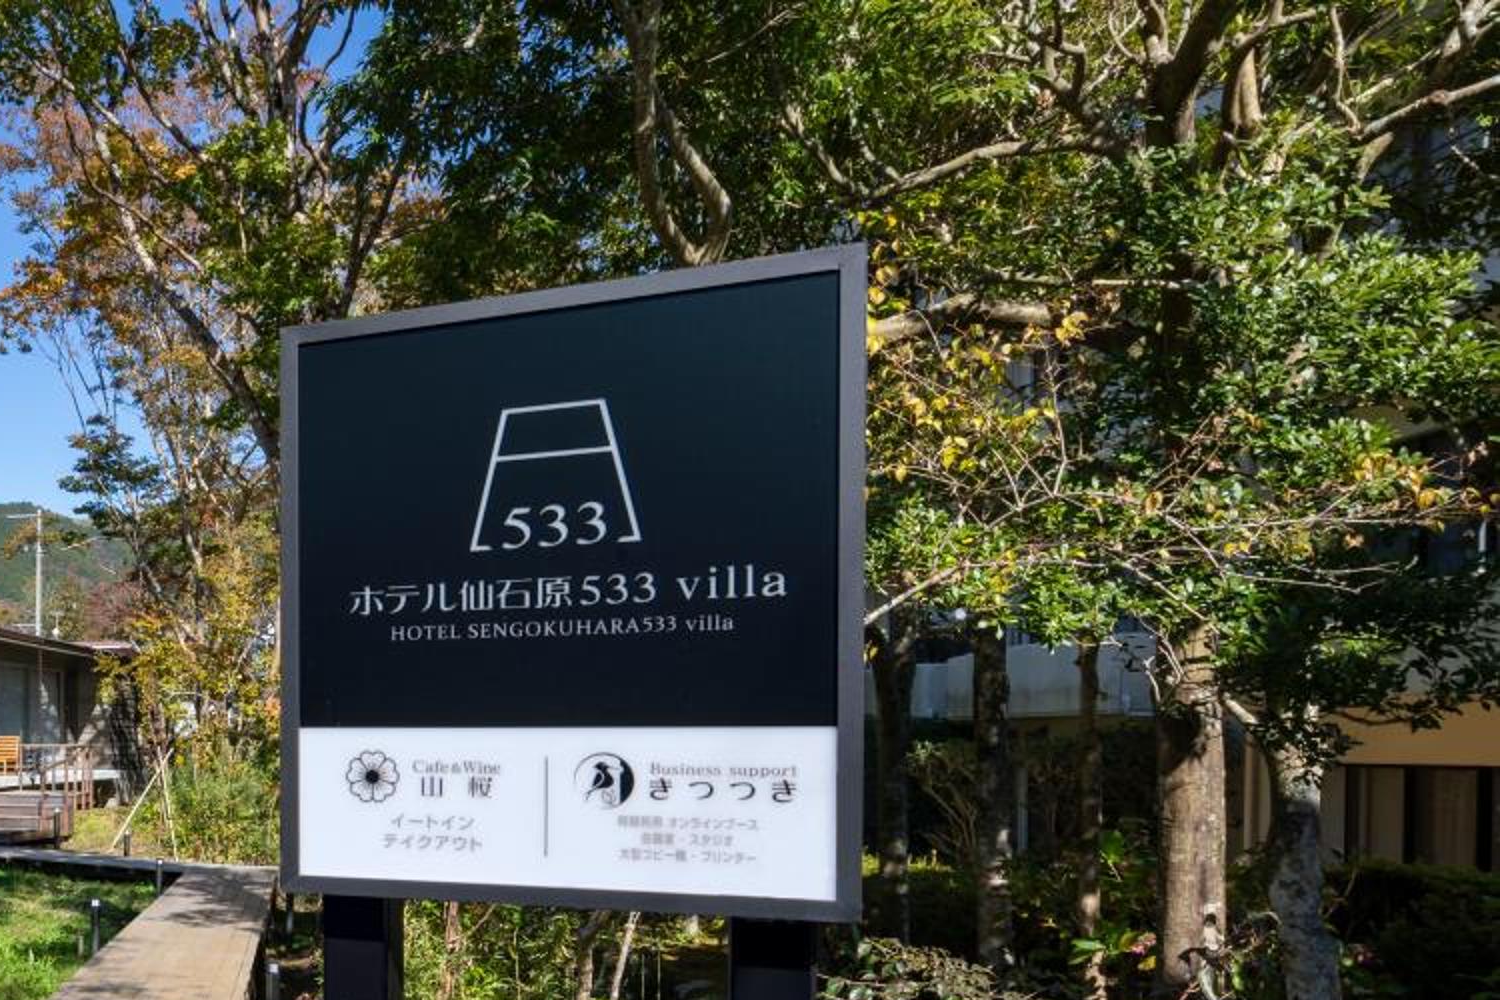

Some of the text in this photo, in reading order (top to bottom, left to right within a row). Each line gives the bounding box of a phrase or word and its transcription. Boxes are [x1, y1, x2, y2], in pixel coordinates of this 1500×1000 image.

[501, 501, 607, 550] 533
[676, 563, 787, 600] villa
[391, 614, 734, 641] HOTEL SENGOKUHARA533 villa
[650, 762, 797, 781] Business support
[390, 812, 475, 831] イートイン
[383, 833, 483, 852] テイクアウト
